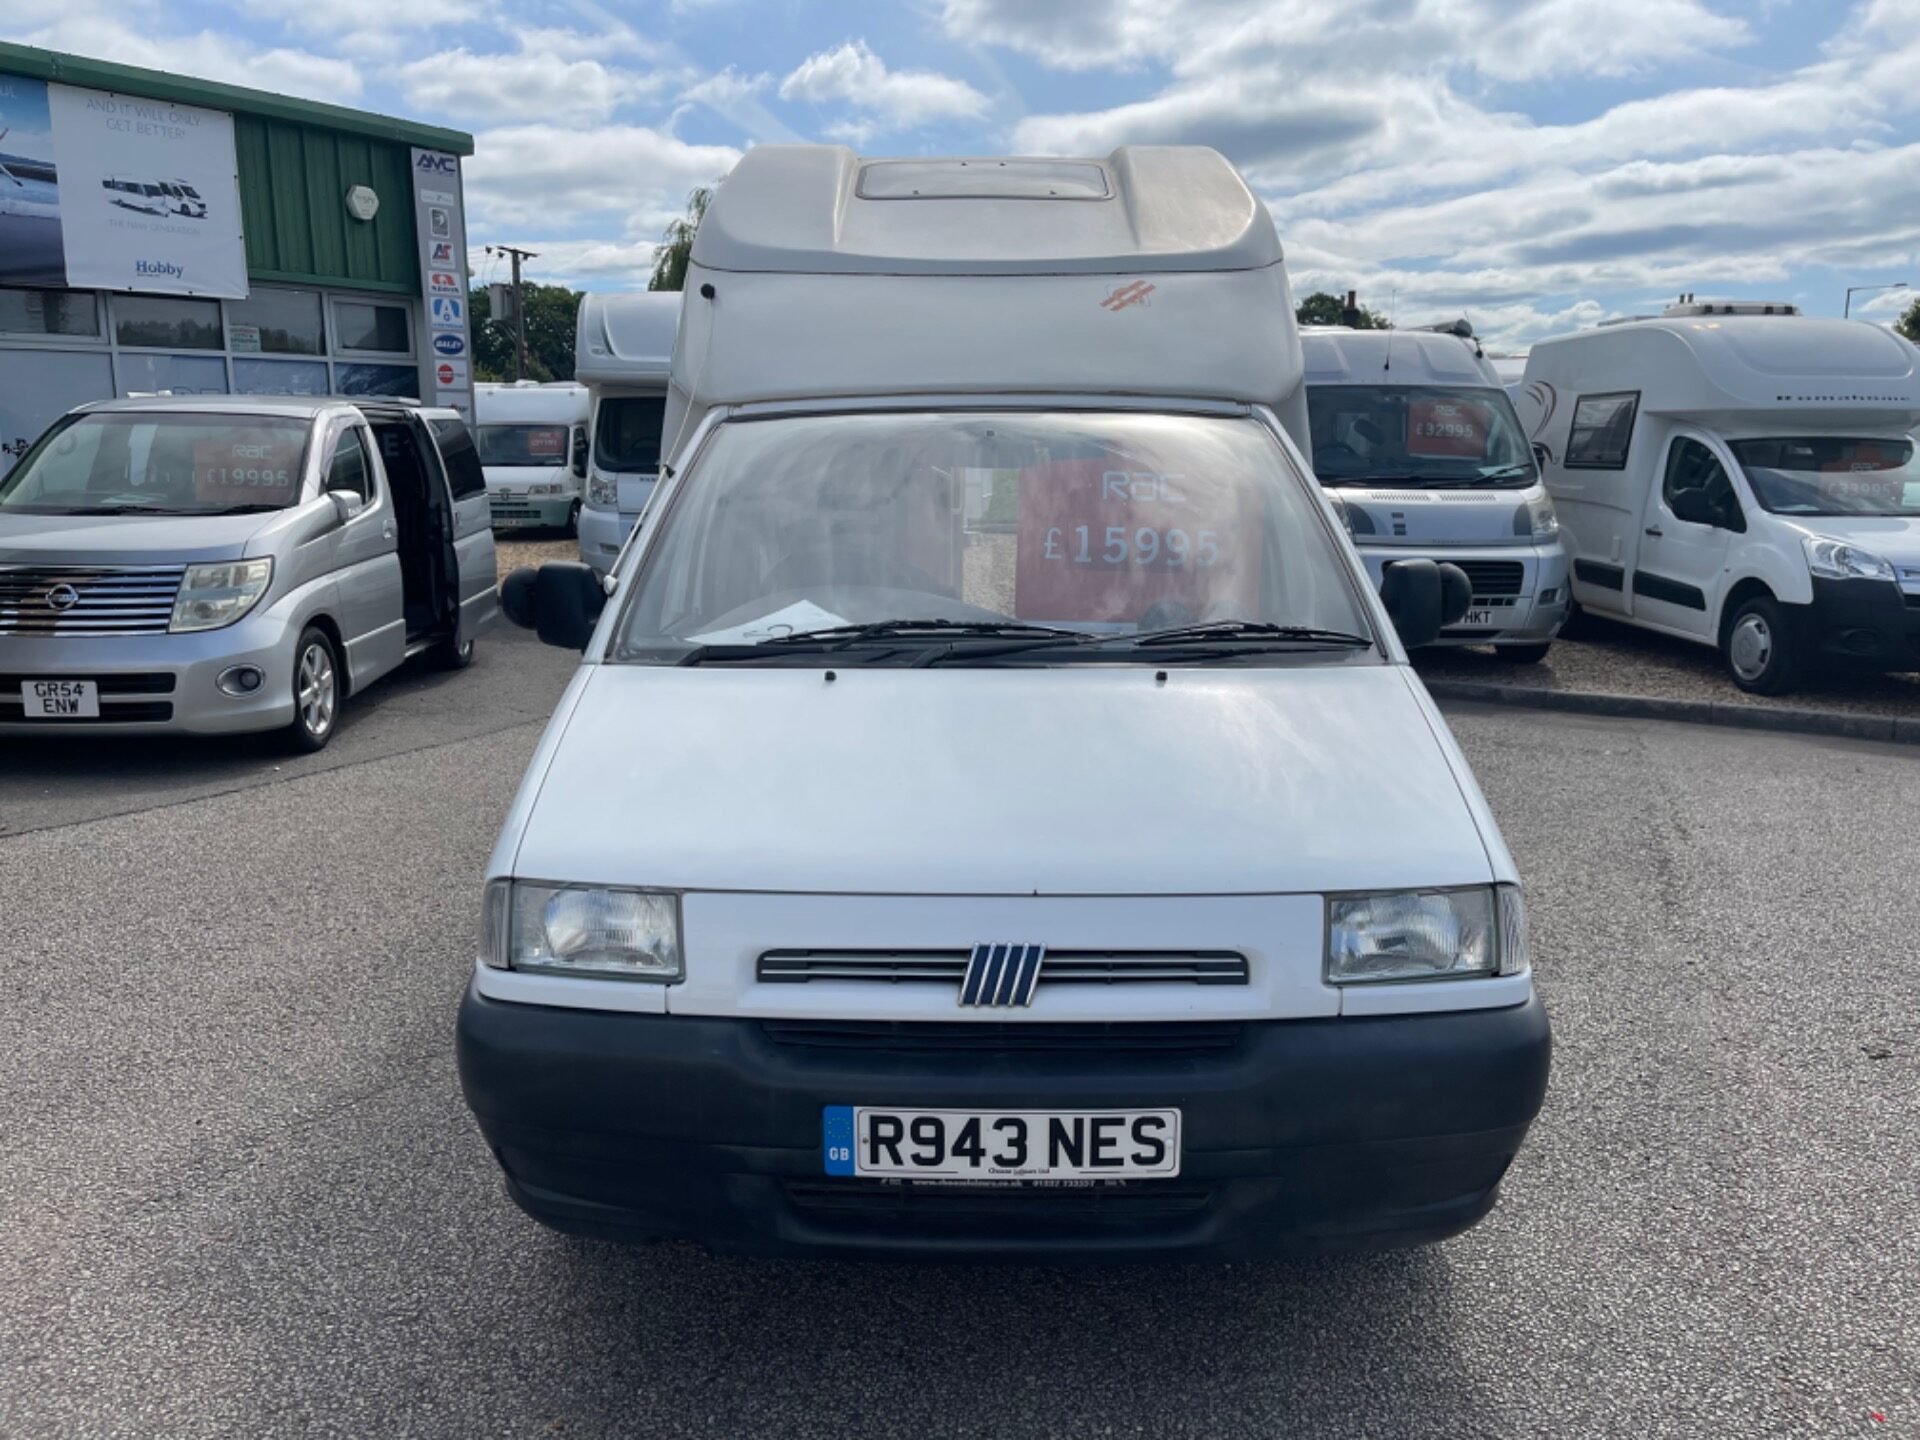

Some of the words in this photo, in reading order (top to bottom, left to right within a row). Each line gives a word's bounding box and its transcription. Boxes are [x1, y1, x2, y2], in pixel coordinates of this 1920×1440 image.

[86, 99, 116, 114] AND
[120, 103, 129, 116] IT
[133, 106, 163, 121] WILL
[168, 110, 201, 126] ONLY
[106, 118, 131, 132] GET
[135, 260, 184, 279] Hobby
[1043, 524, 1220, 567] £15995
[34, 682, 85, 697] GR54
[43, 698, 79, 714] ENW
[868, 1114, 1028, 1168] R943
[1049, 1116, 1167, 1168] NES
[828, 1146, 850, 1161] GB
